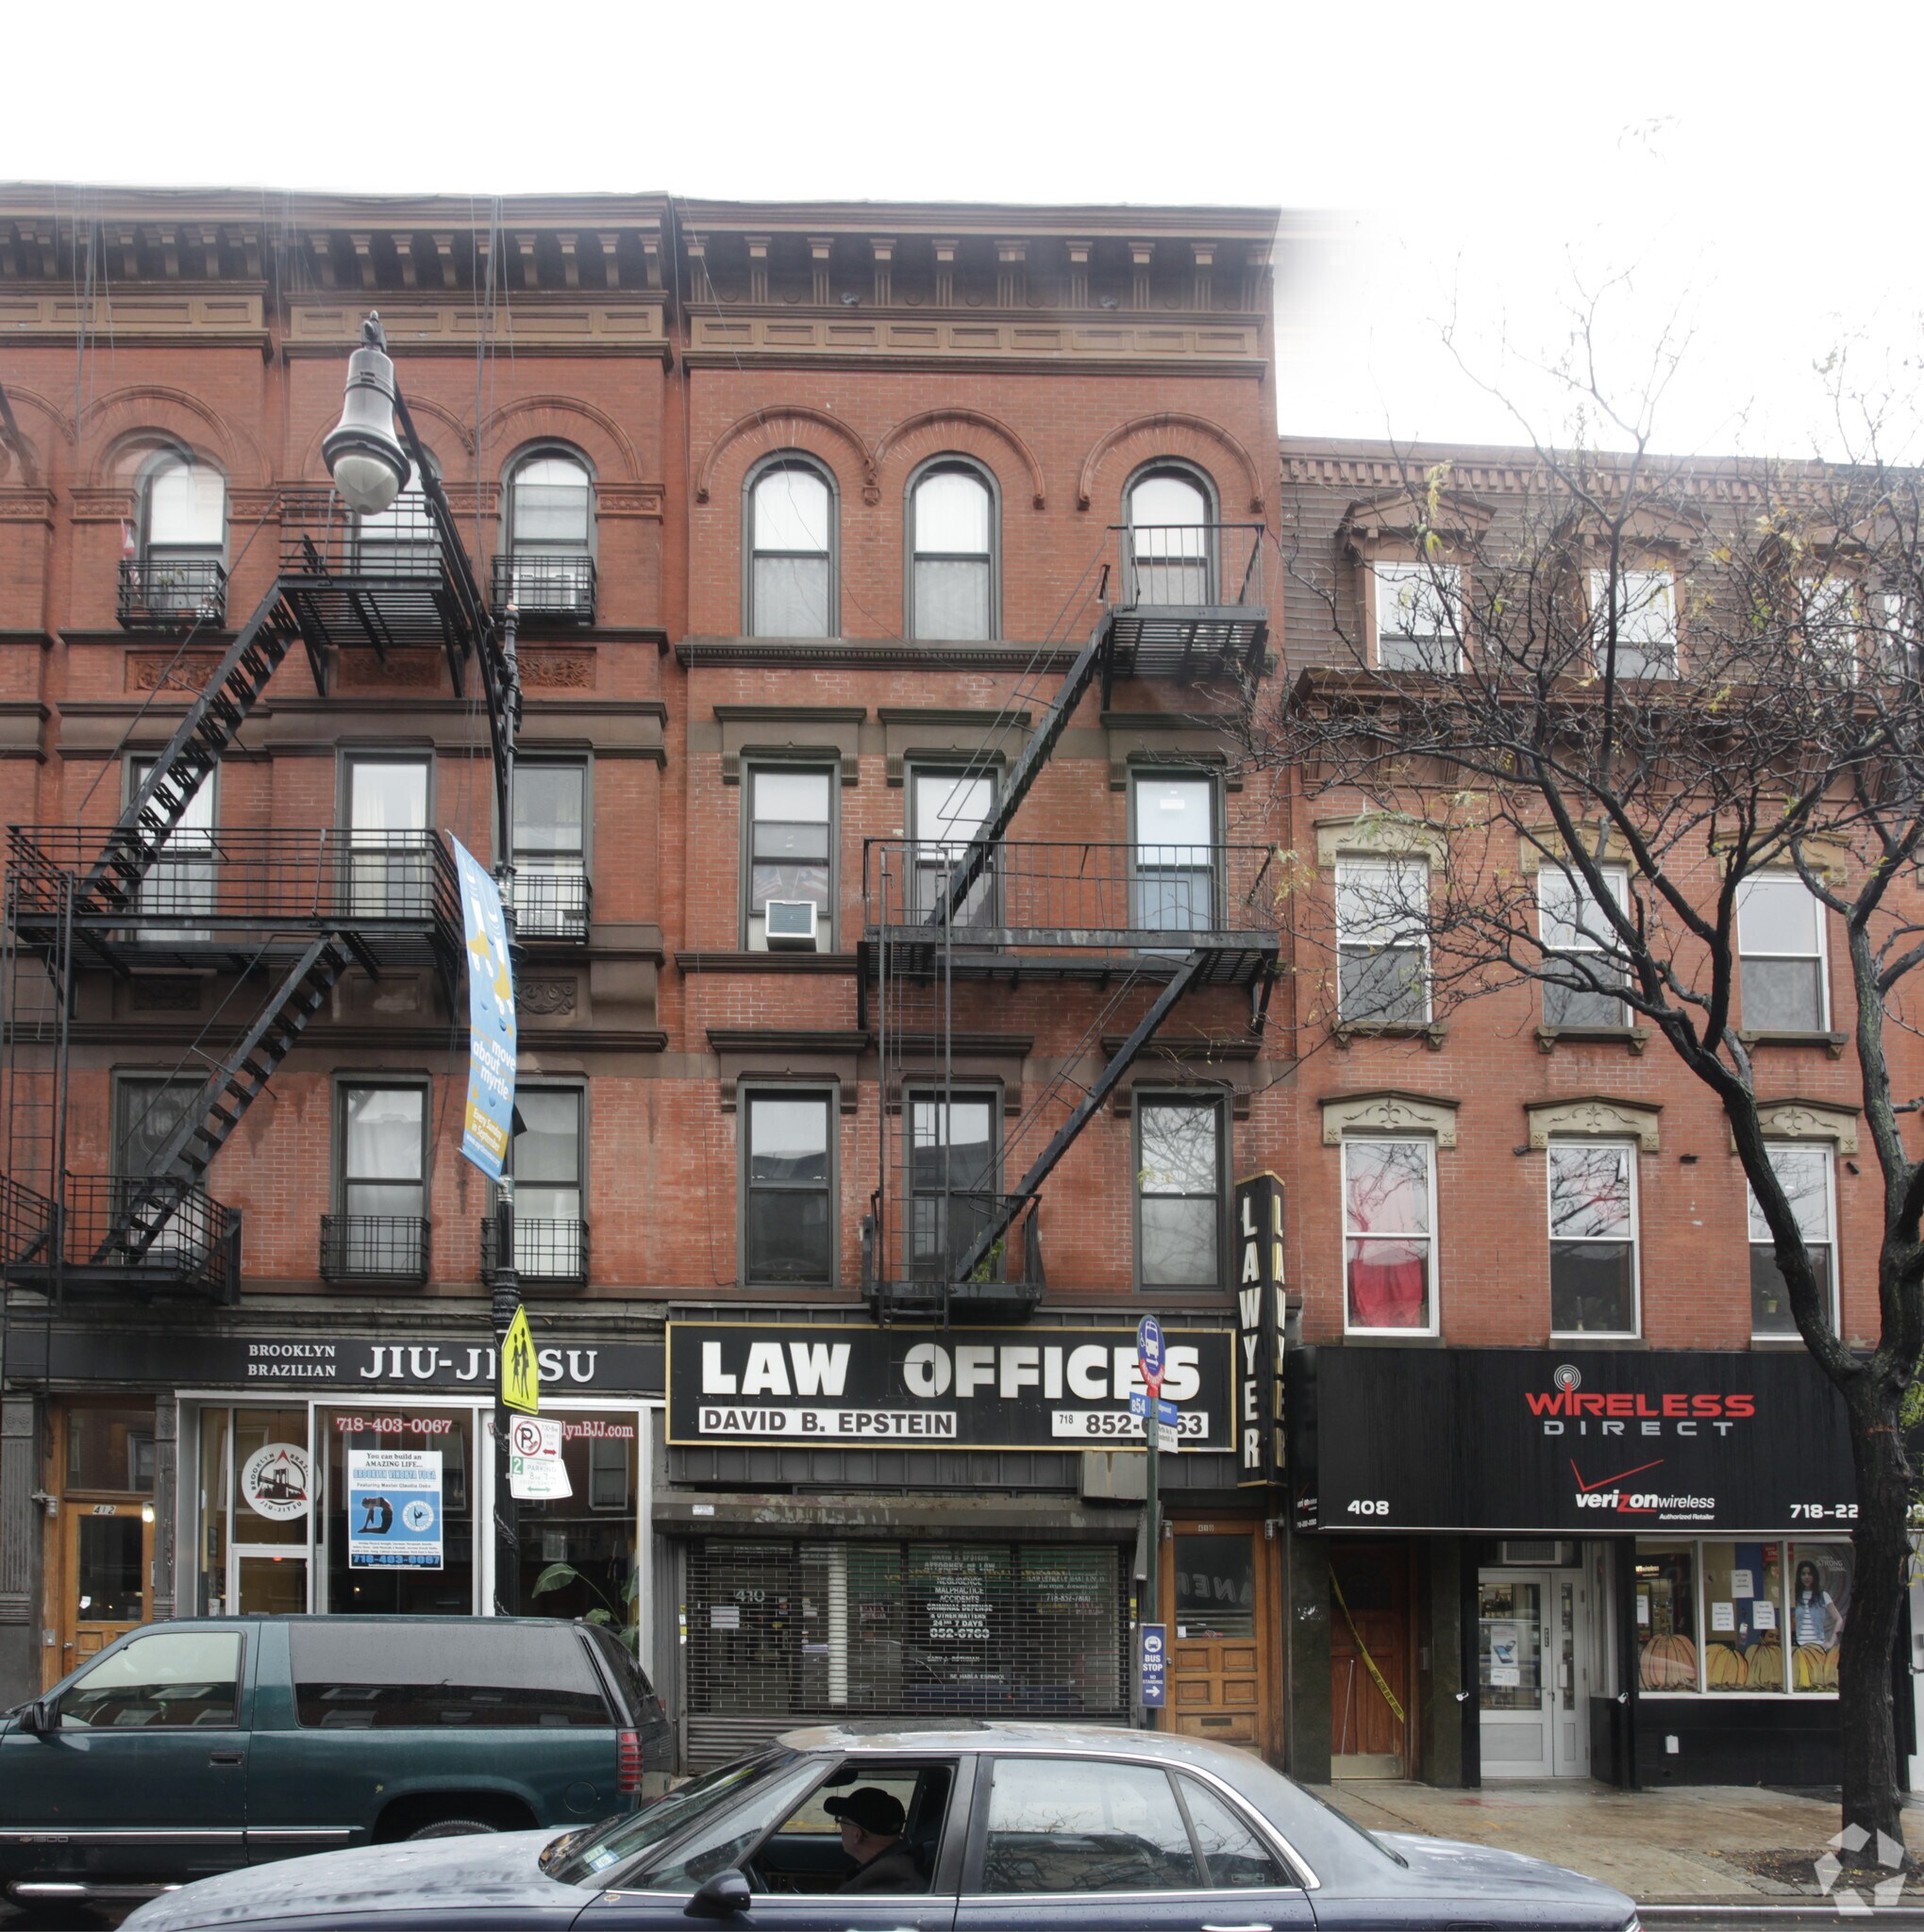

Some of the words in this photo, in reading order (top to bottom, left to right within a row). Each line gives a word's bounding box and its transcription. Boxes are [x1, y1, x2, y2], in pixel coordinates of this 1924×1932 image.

[473, 1041, 501, 1074] about
[492, 1039, 516, 1071] move
[480, 1065, 509, 1100] myrtle
[473, 1108, 486, 1127] Every
[486, 1119, 502, 1141] Sunday
[1239, 1195, 1261, 1469] LAWYER
[1272, 1194, 1287, 1469] LAWYER
[248, 1344, 336, 1357] BROOKLYN
[247, 1364, 337, 1377] BRAZILIAN
[360, 1346, 597, 1382] JIU-JISU
[702, 1341, 851, 1395] LAW
[903, 1342, 1200, 1400] OFFICES
[1131, 1399, 1146, 1414] B54
[1525, 1383, 1755, 1417] WIRELESS
[336, 1417, 452, 1433] 718-403-0067
[704, 1409, 786, 1431] DAVID
[802, 1412, 826, 1432] B.
[838, 1413, 952, 1434] EPSTEIN
[1059, 1415, 1074, 1425] 718
[1544, 1421, 1733, 1436] DIRECT
[251, 1453, 275, 1491] BROOKLYN
[513, 1457, 523, 1474] 2
[259, 1501, 302, 1512] JIU-JITSU
[1347, 1500, 1389, 1515] 408
[1575, 1490, 1658, 1512] verizon
[1658, 1494, 1715, 1508] wireless
[93, 1506, 115, 1514] 412
[353, 1555, 440, 1564] 718-403-0067
[924, 1562, 963, 1571] ATTORNEY
[936, 1576, 982, 1586] NEGLIGENCE
[735, 1589, 765, 1603] 410
[962, 1604, 993, 1612] DEFENSE
[929, 1628, 990, 1639] 852-6763
[1143, 1663, 1163, 1672] STOP
